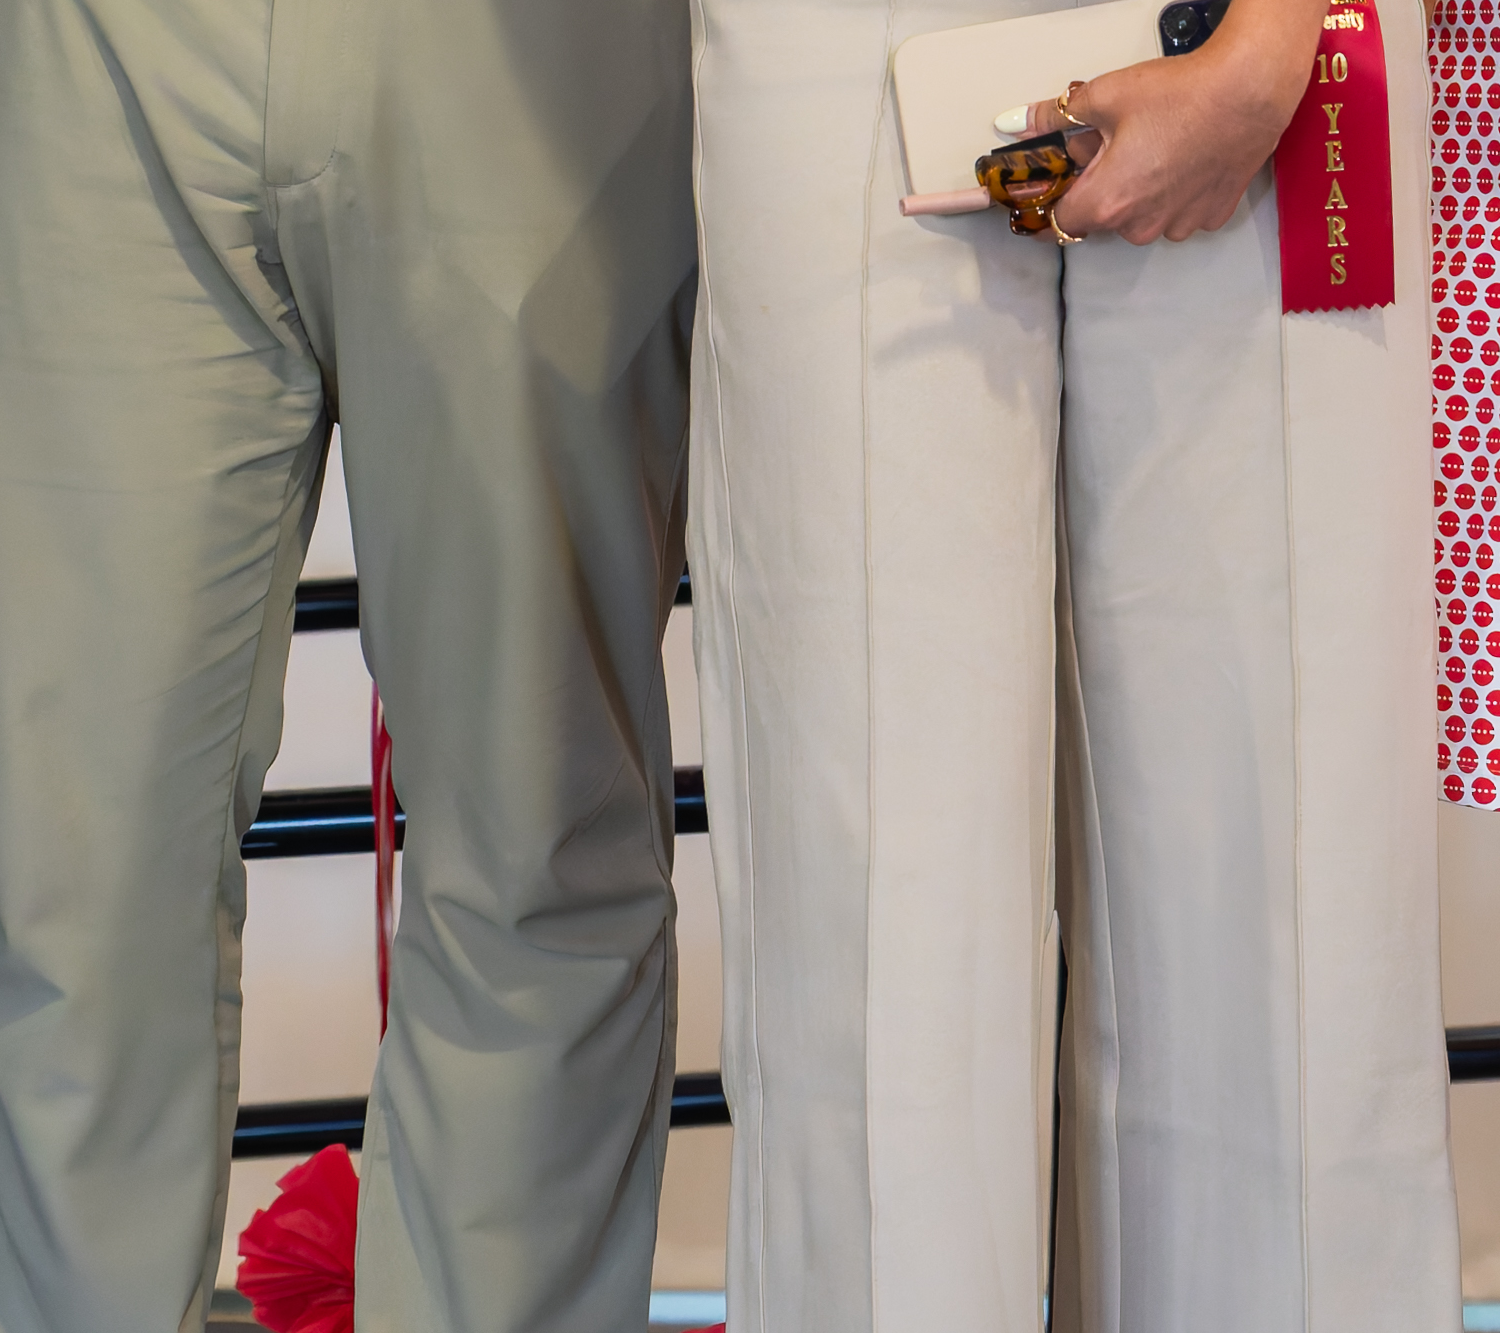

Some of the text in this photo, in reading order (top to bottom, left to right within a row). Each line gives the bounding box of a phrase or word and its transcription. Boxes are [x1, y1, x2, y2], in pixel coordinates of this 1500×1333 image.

[1323, 8, 1364, 31] ersity
[1317, 52, 1348, 83] 10
[1321, 103, 1349, 286] YEARS
